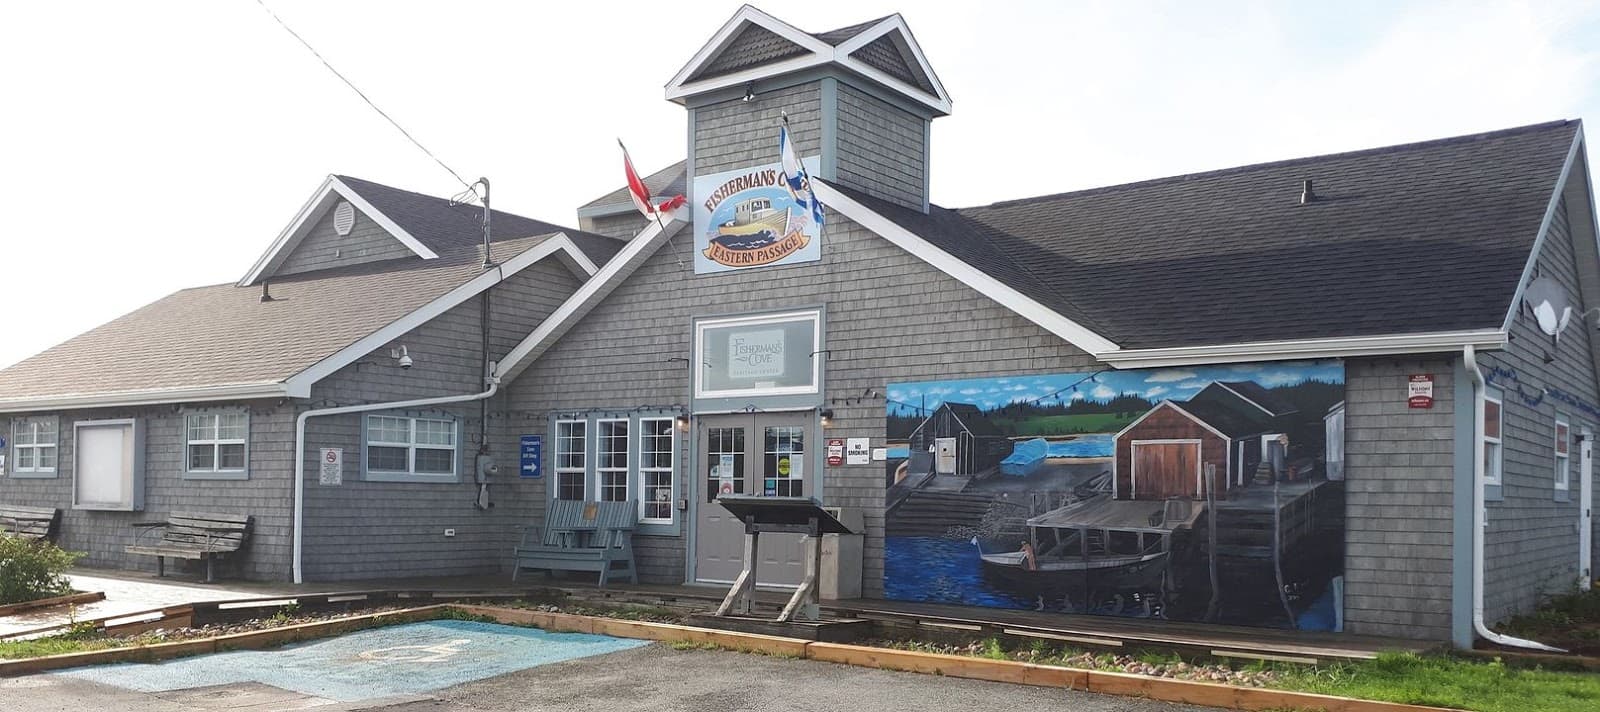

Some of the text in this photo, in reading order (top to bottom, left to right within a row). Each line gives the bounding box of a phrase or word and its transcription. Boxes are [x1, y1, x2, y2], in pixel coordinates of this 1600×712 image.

[704, 169, 776, 213] FISHERMAN'S
[713, 234, 799, 264] EASTERN PASSAGE
[748, 353, 773, 367] COVE
